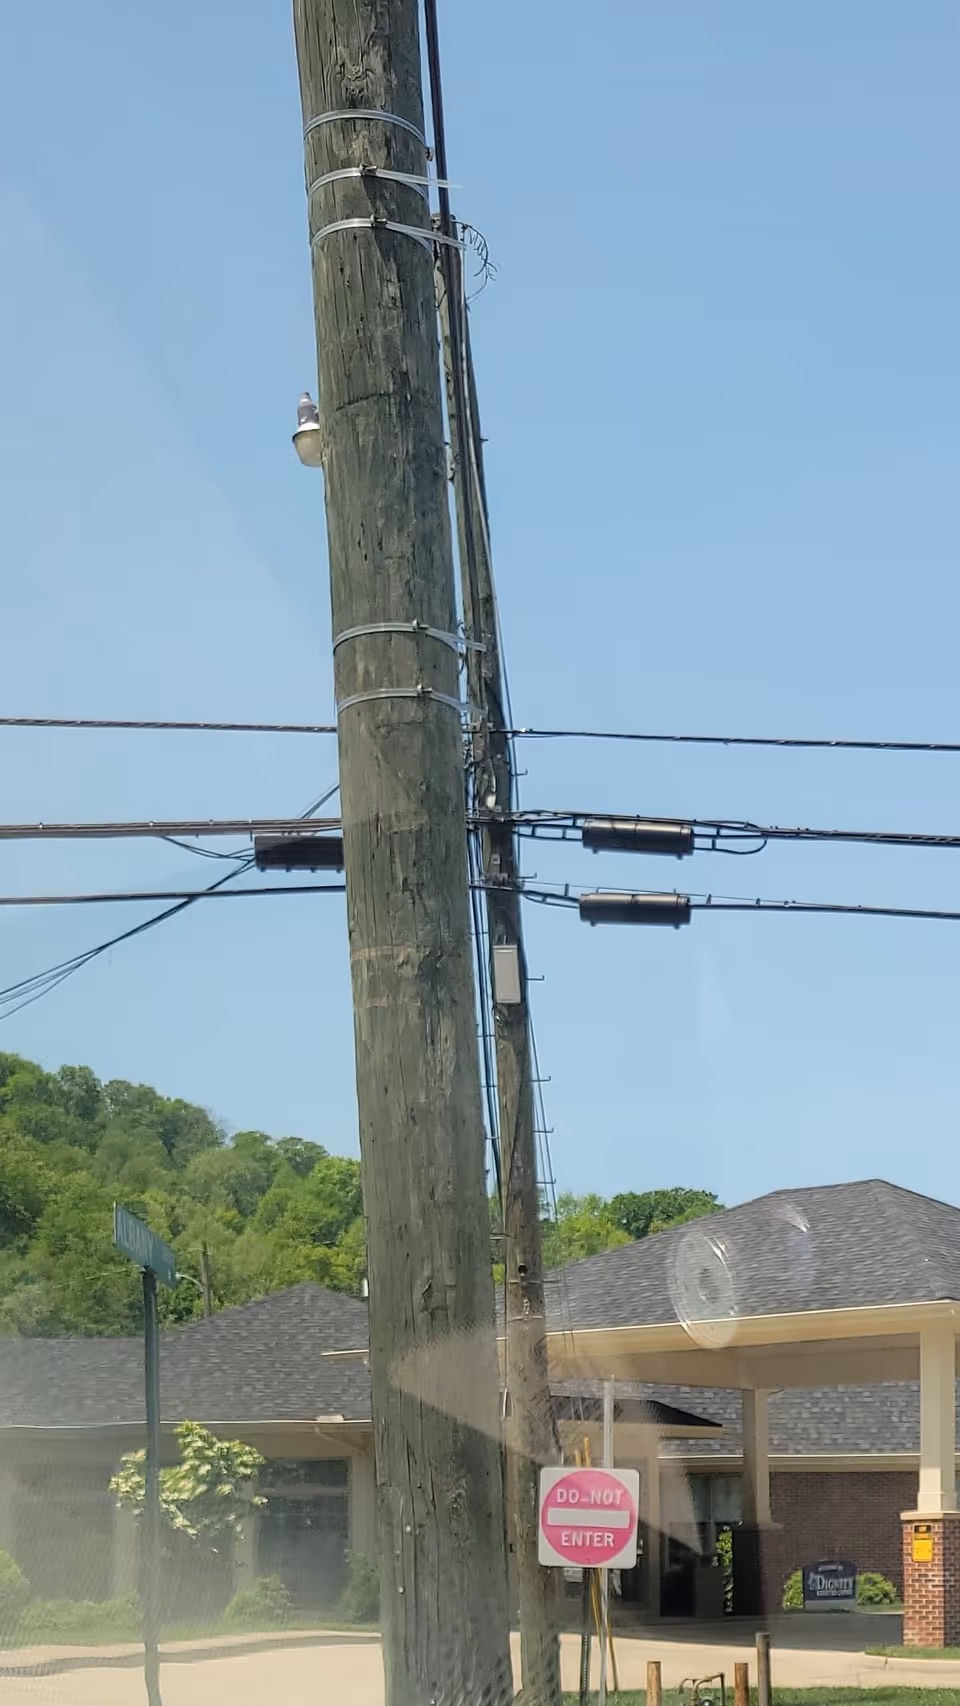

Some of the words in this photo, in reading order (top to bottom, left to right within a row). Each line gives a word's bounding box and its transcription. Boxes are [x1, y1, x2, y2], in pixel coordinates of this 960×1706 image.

[117, 1209, 154, 1265] ALBANY
[557, 1488, 580, 1504] DO
[590, 1488, 625, 1505] NOT
[561, 1530, 615, 1548] ENTER
